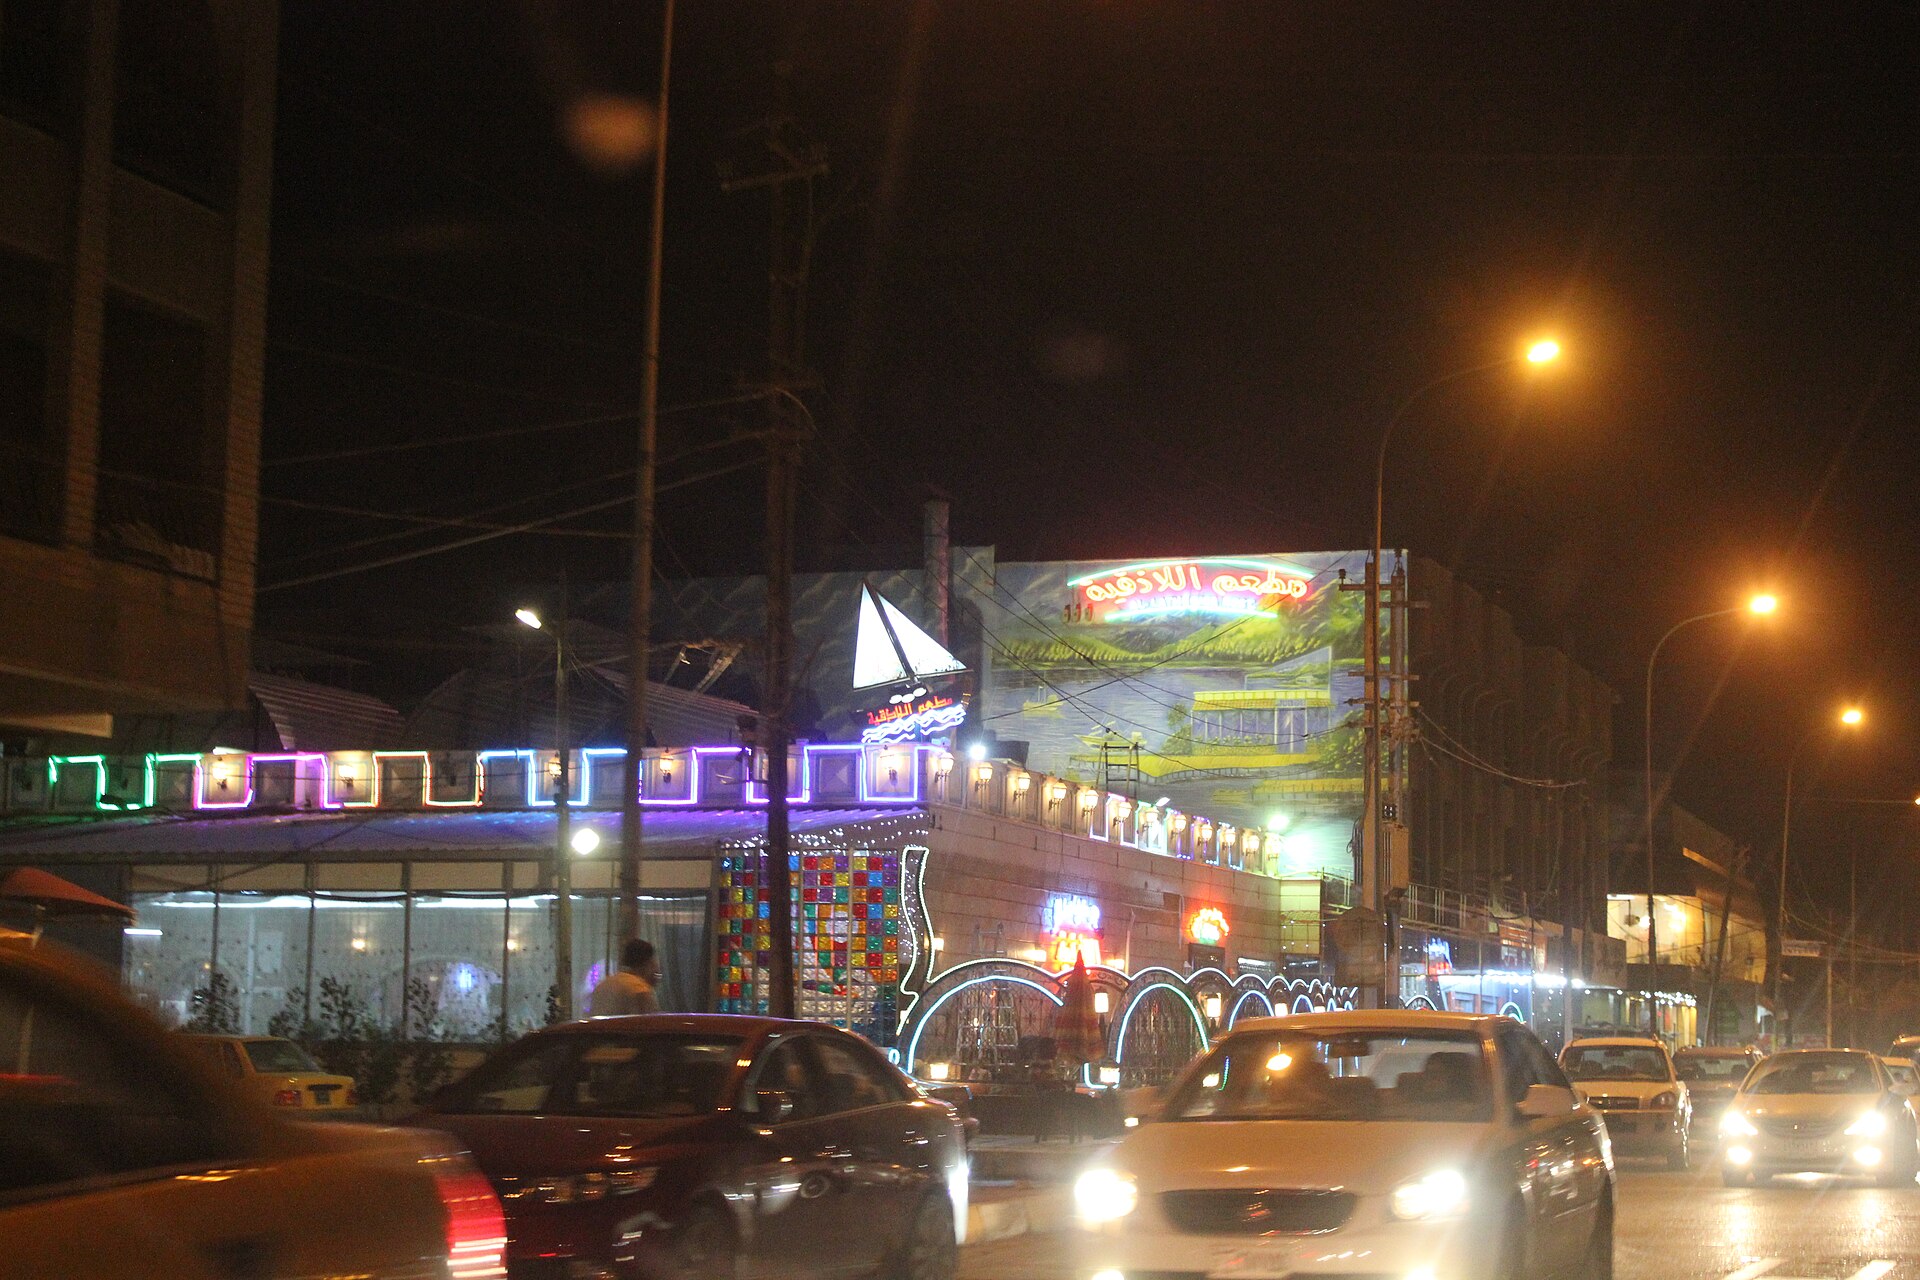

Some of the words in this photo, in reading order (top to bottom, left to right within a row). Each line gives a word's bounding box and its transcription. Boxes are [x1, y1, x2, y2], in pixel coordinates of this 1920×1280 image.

[1079, 565, 1202, 604] اللاذقية
[1213, 568, 1307, 598] مطعم
[867, 703, 912, 725] اللاذقية
[918, 696, 952, 714] مطعم
